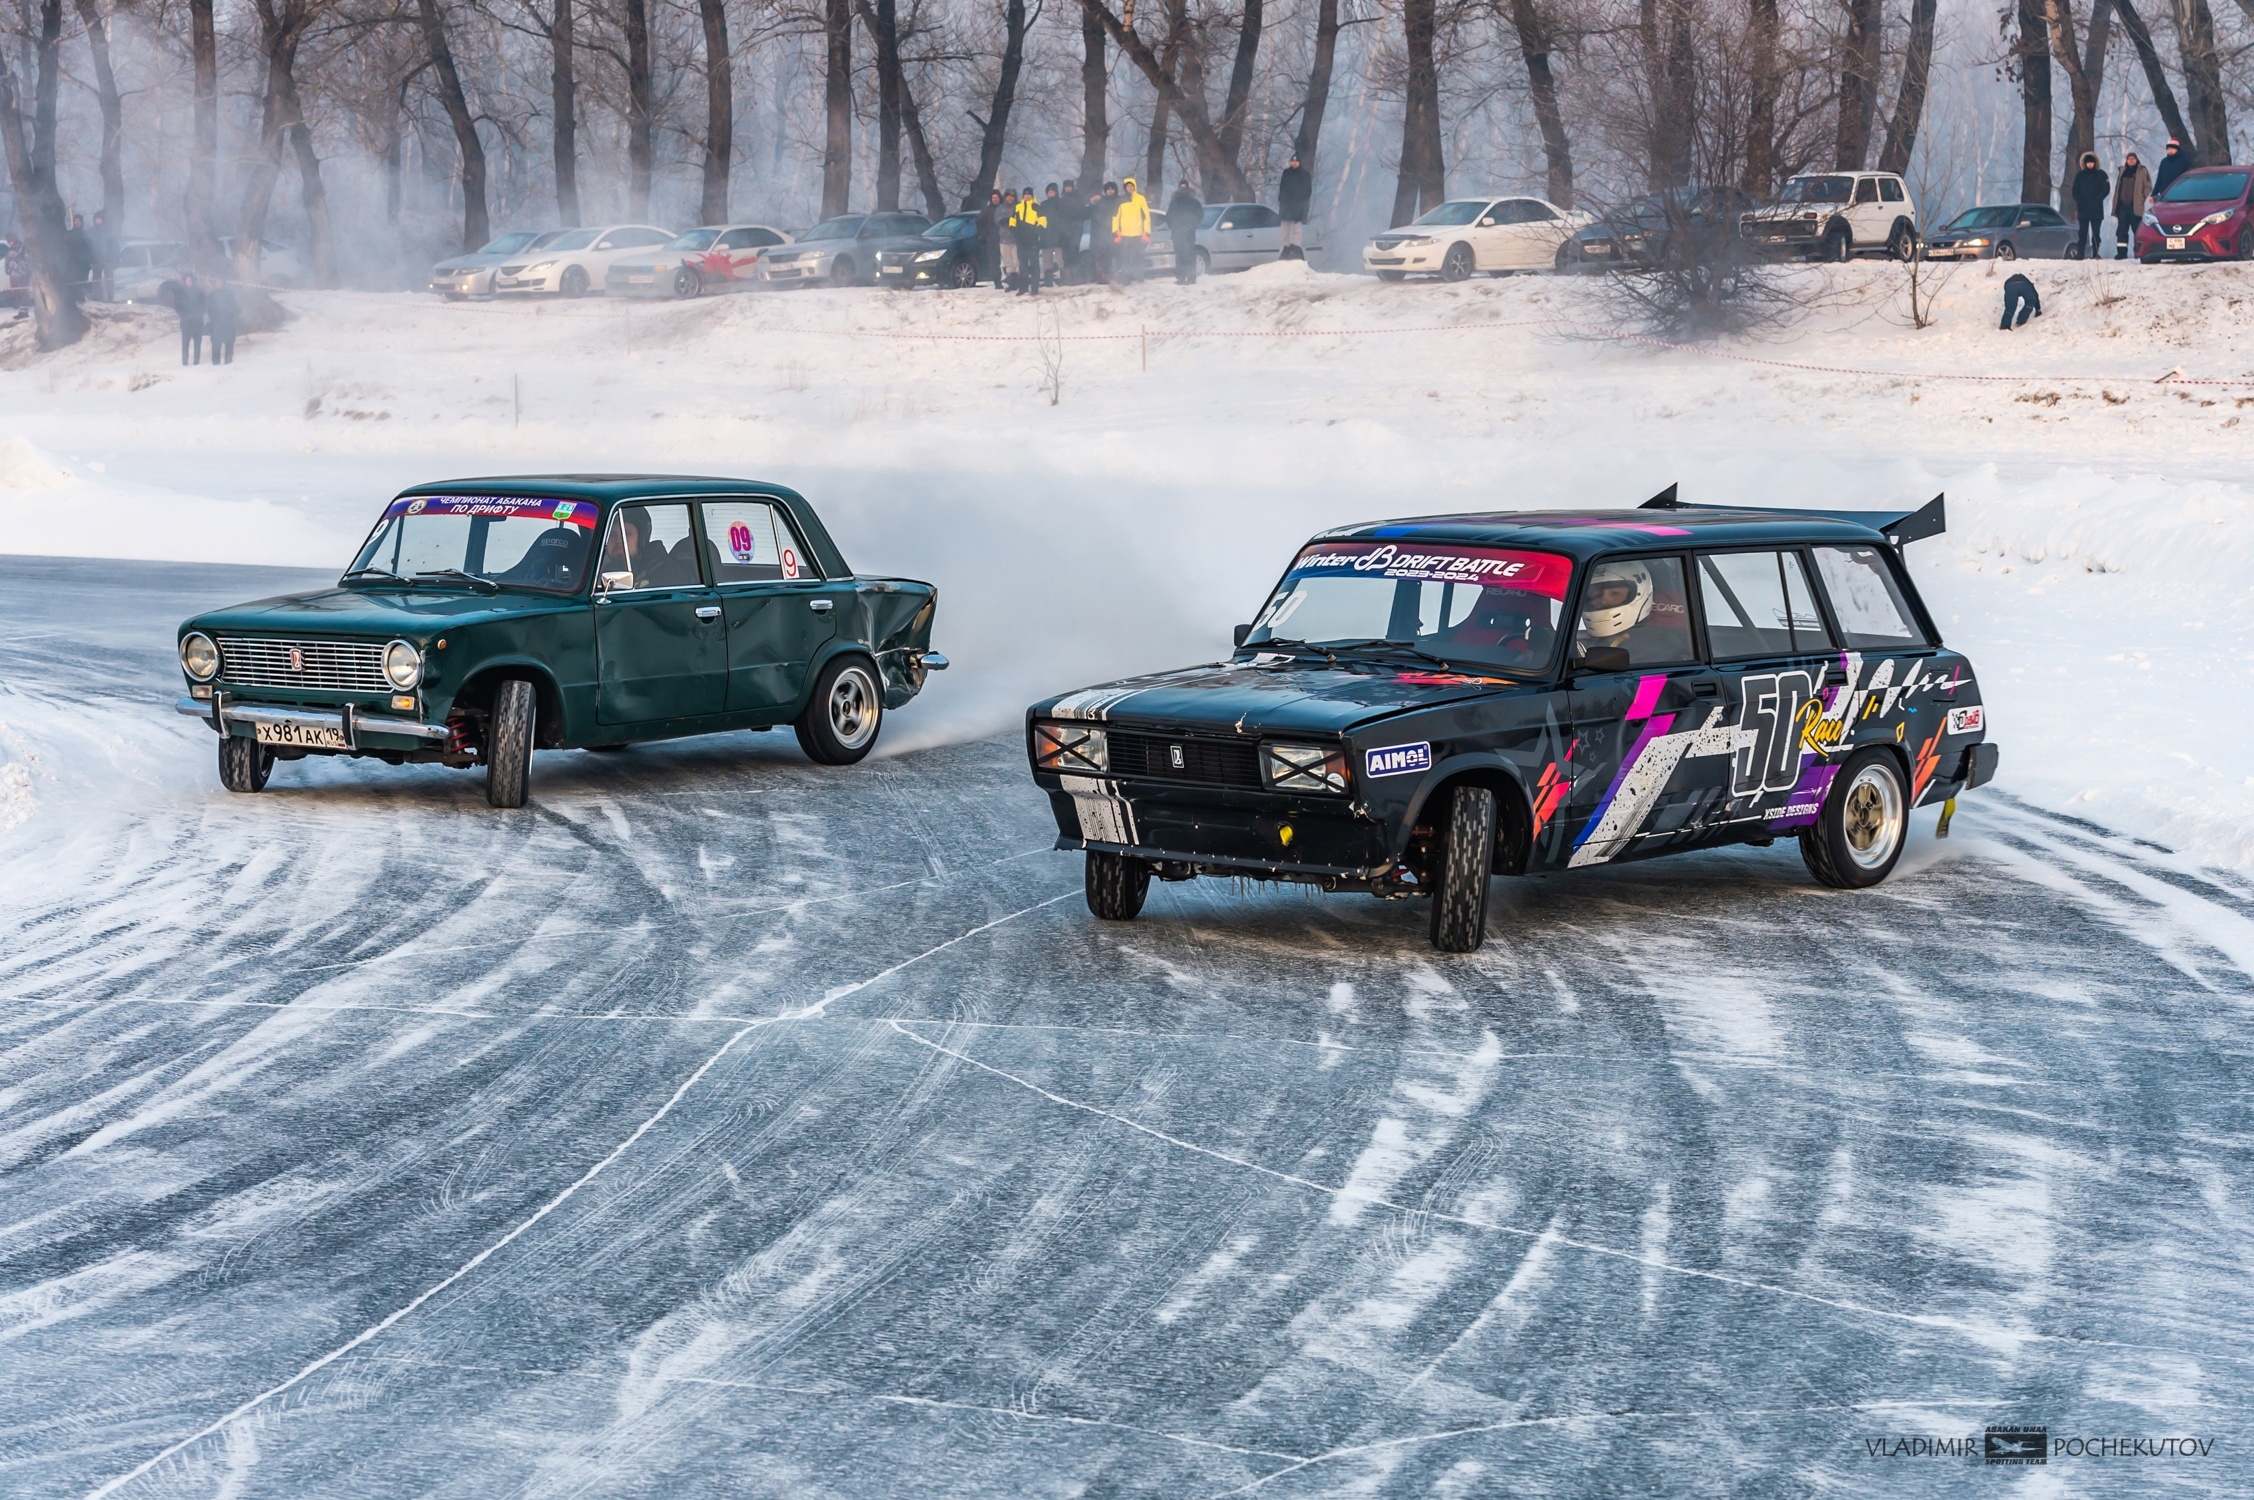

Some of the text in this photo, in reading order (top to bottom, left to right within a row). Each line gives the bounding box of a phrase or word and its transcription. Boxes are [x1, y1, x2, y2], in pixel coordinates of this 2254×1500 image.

[440, 497, 542, 507] ЧЕМПИОНАТ АБАКАНА
[450, 505, 519, 515] ПО ДРИФТУ
[730, 526, 752, 552] 09
[783, 549, 797, 577] 9
[1294, 553, 1356, 570] Winter
[1390, 554, 1453, 569] DRIFT
[1446, 557, 1525, 577] BATTLE
[1383, 568, 1479, 581] 2023-2024
[1485, 587, 1527, 597] RECARO
[1648, 602, 1684, 613] ECARO
[326, 728, 340, 741] 19
[1732, 671, 1813, 797] 50
[1763, 803, 1819, 821] XSIDE DESIGNS
